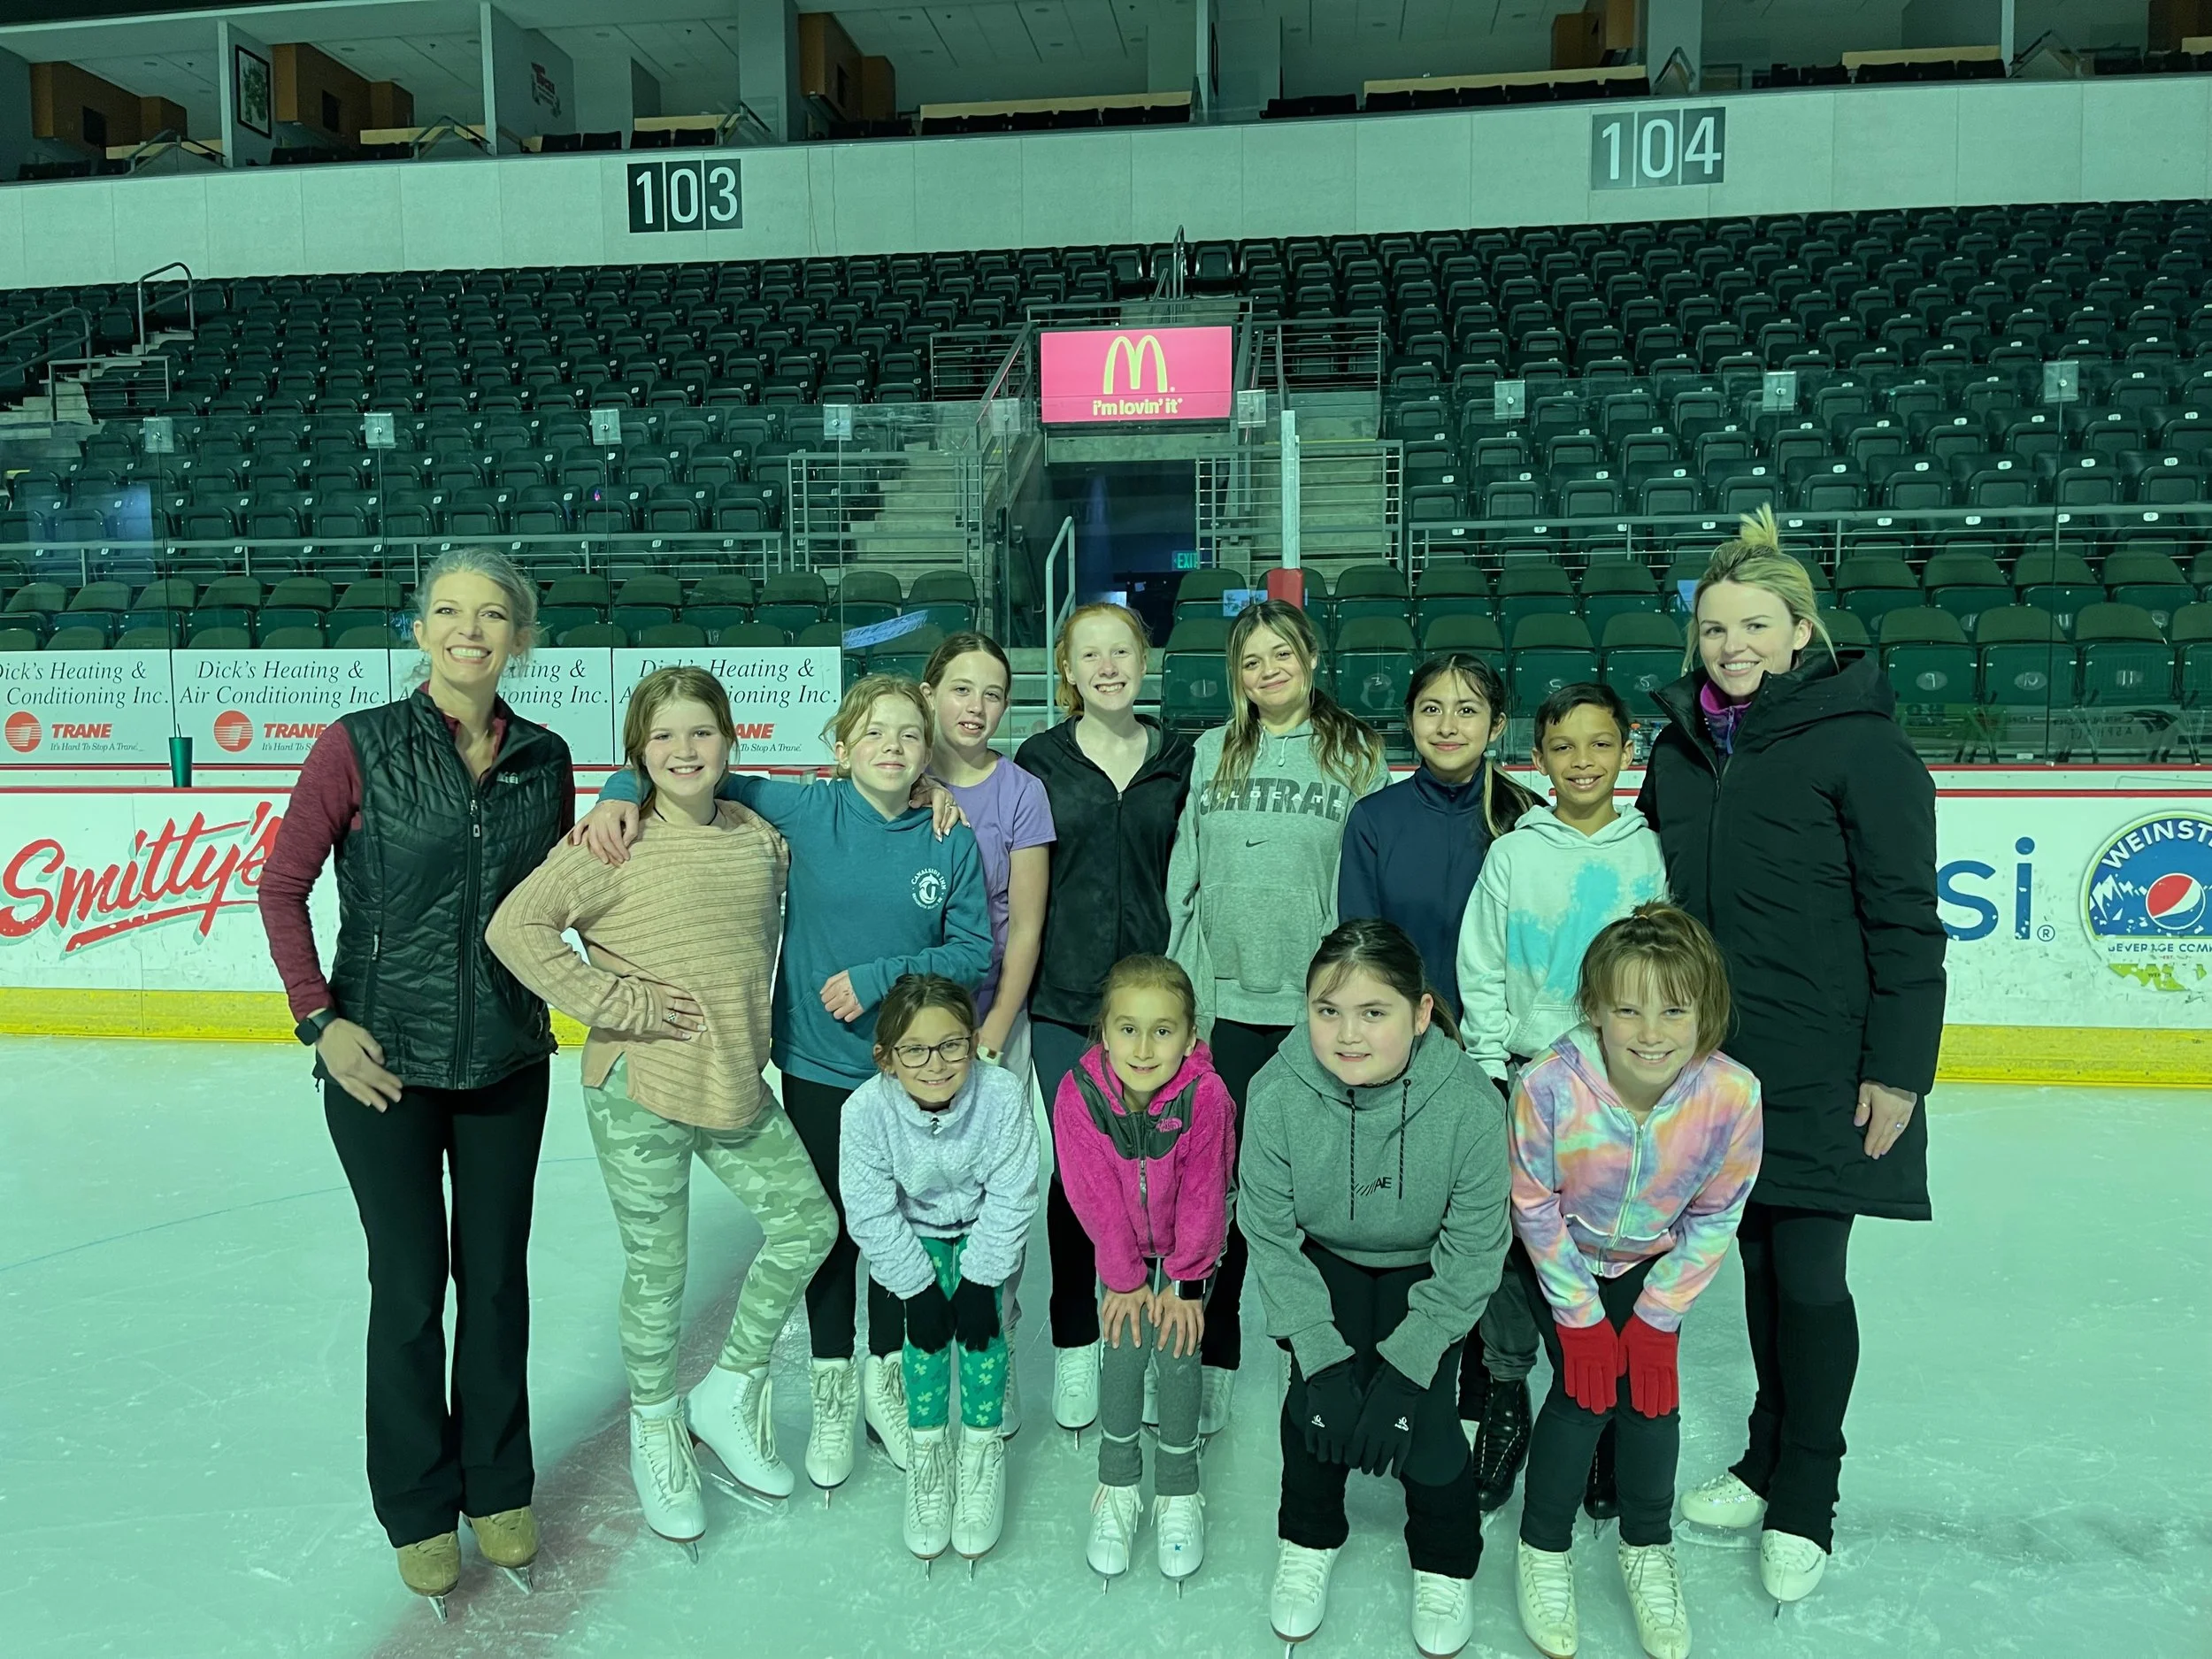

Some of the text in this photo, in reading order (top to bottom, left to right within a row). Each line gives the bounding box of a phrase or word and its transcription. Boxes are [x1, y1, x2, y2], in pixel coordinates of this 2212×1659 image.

[1602, 117, 1722, 180] 104
[636, 166, 738, 224] 103
[1093, 398, 1179, 416] i'm lovin' it
[1178, 553, 1198, 569] EXIT
[50, 662, 123, 684] Heating
[131, 660, 147, 680] &
[197, 659, 365, 684] Dick's Heating &
[501, 658, 587, 682] ating &
[710, 658, 789, 682] Heating
[797, 657, 815, 678] &
[7, 686, 169, 709] Conditioning Inc.
[179, 686, 211, 704] Air
[217, 686, 342, 709] Conditioning
[349, 686, 386, 704] Inc.
[499, 686, 563, 709] ioning
[569, 686, 609, 703] Inc.
[728, 684, 838, 709] ioning Inc.
[51, 723, 113, 739] TRANE
[263, 723, 327, 739] TRANE
[734, 723, 775, 739] ANE
[50, 742, 61, 751] It's
[61, 742, 81, 751] Hard
[82, 742, 91, 751] To
[92, 742, 110, 753] Stop
[262, 742, 273, 751] It's
[273, 742, 294, 751] Hard
[295, 742, 304, 751] To
[750, 743, 770, 753] Stop
[2101, 819, 2212, 869] WEINST
[0, 802, 284, 938] Smitty's
